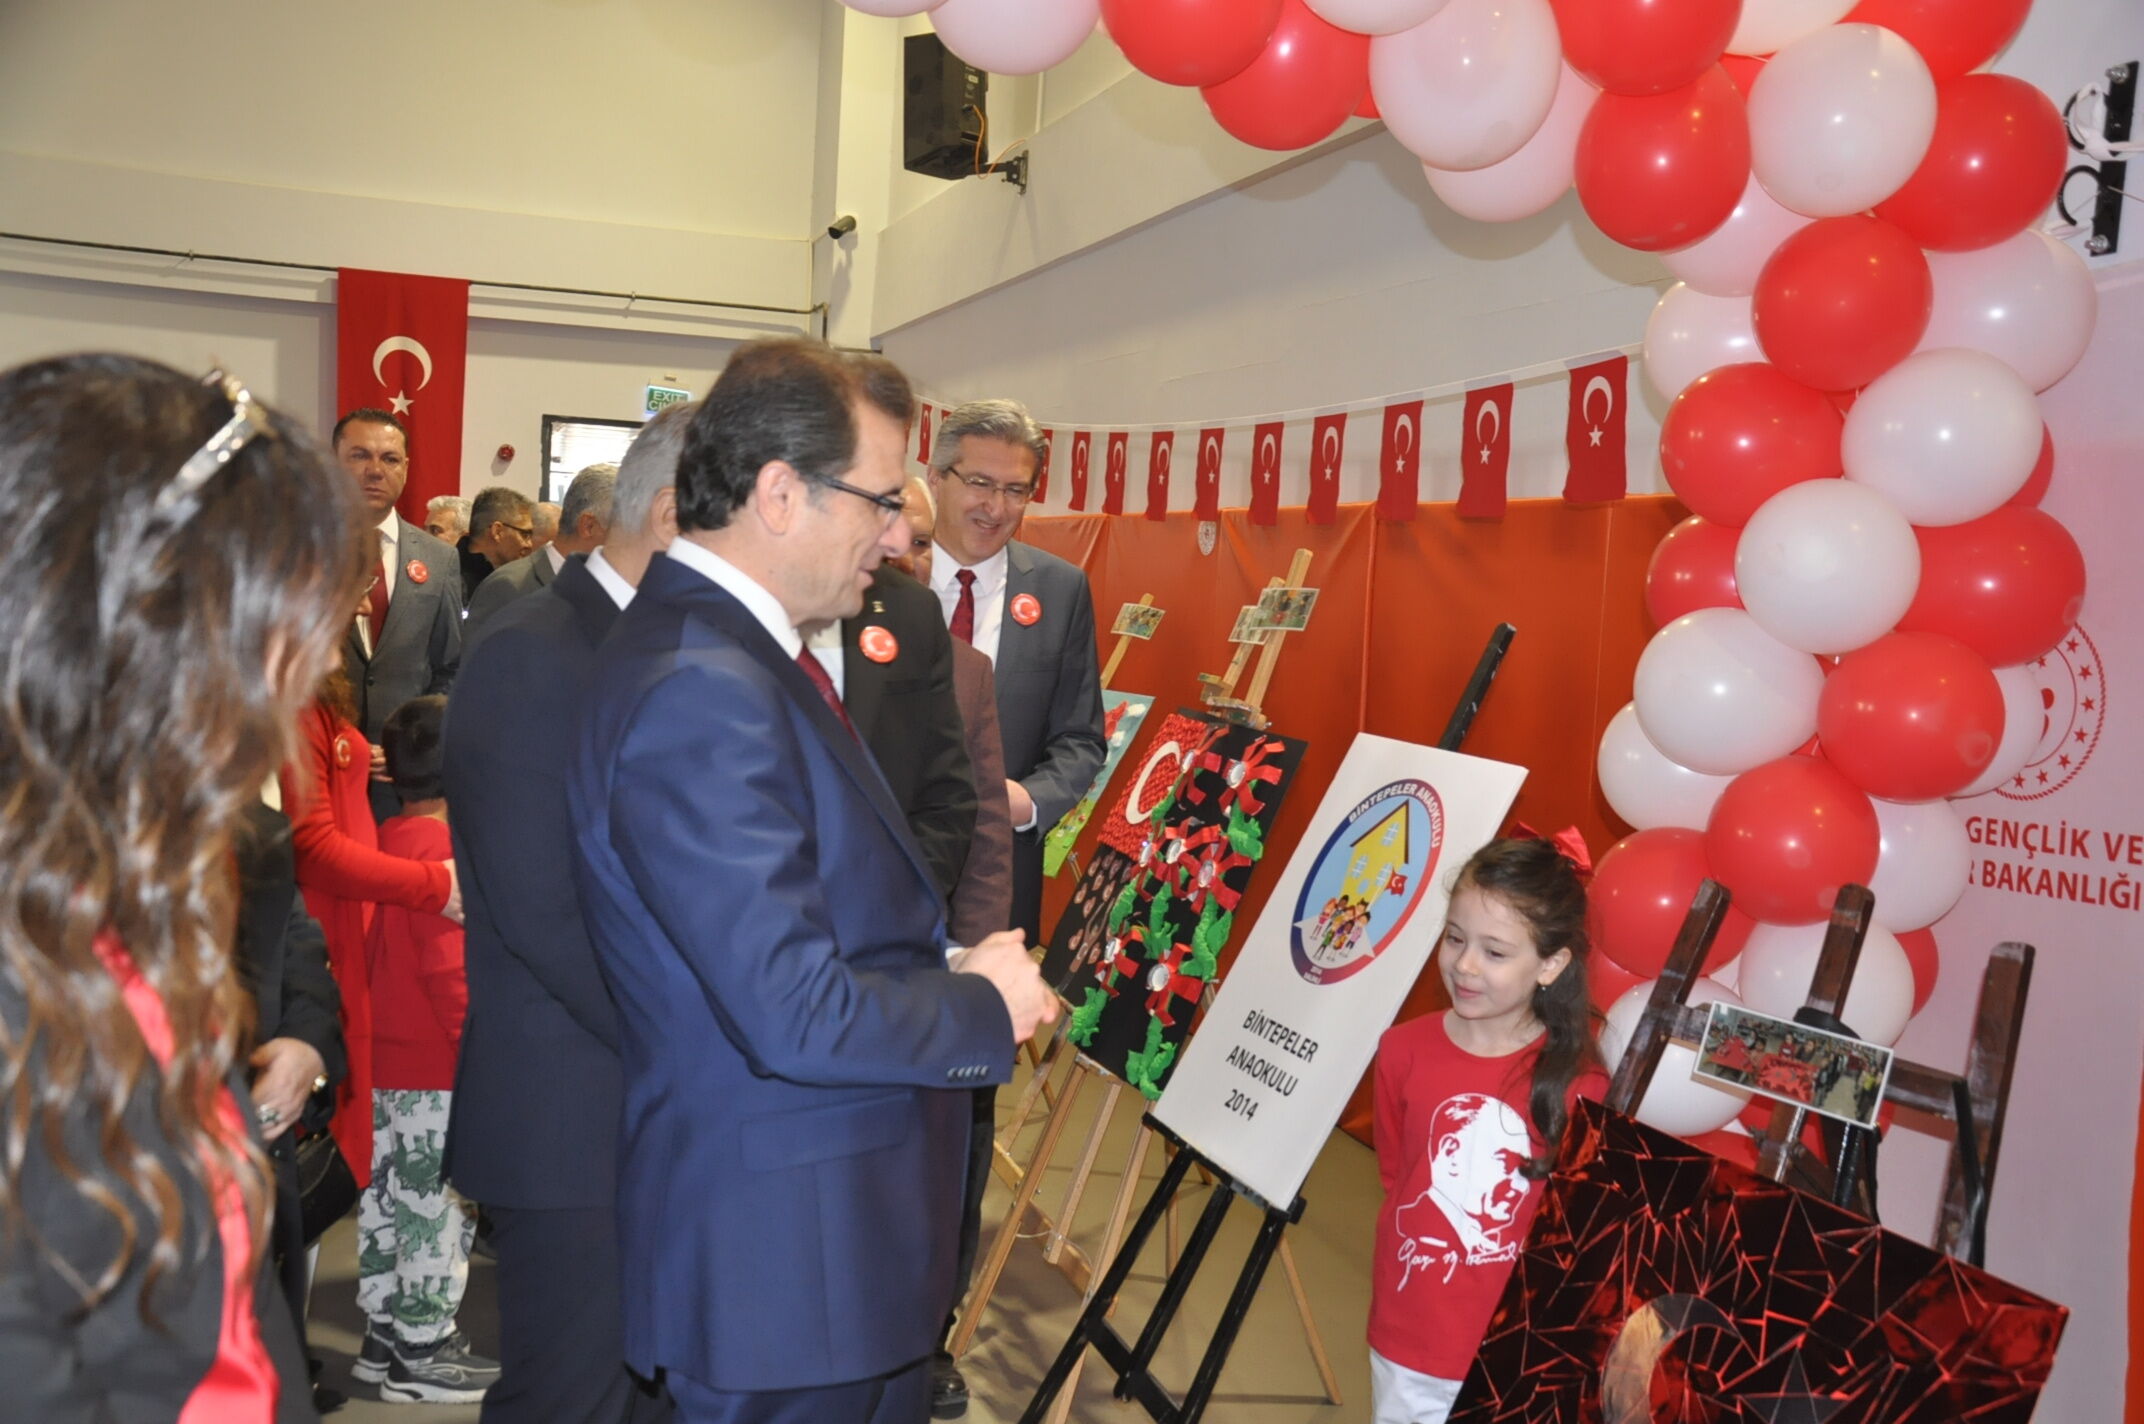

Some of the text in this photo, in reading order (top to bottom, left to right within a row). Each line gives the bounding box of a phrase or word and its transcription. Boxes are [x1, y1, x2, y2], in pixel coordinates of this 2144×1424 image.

[1965, 816, 2144, 866] GENÇLİK VE
[1981, 859, 2142, 912] BAKANLIĞI
[1242, 1009, 1319, 1064] BİNTEPELER
[1225, 1045, 1299, 1097] ANAOKULU
[1224, 1088, 1259, 1121] 2014
